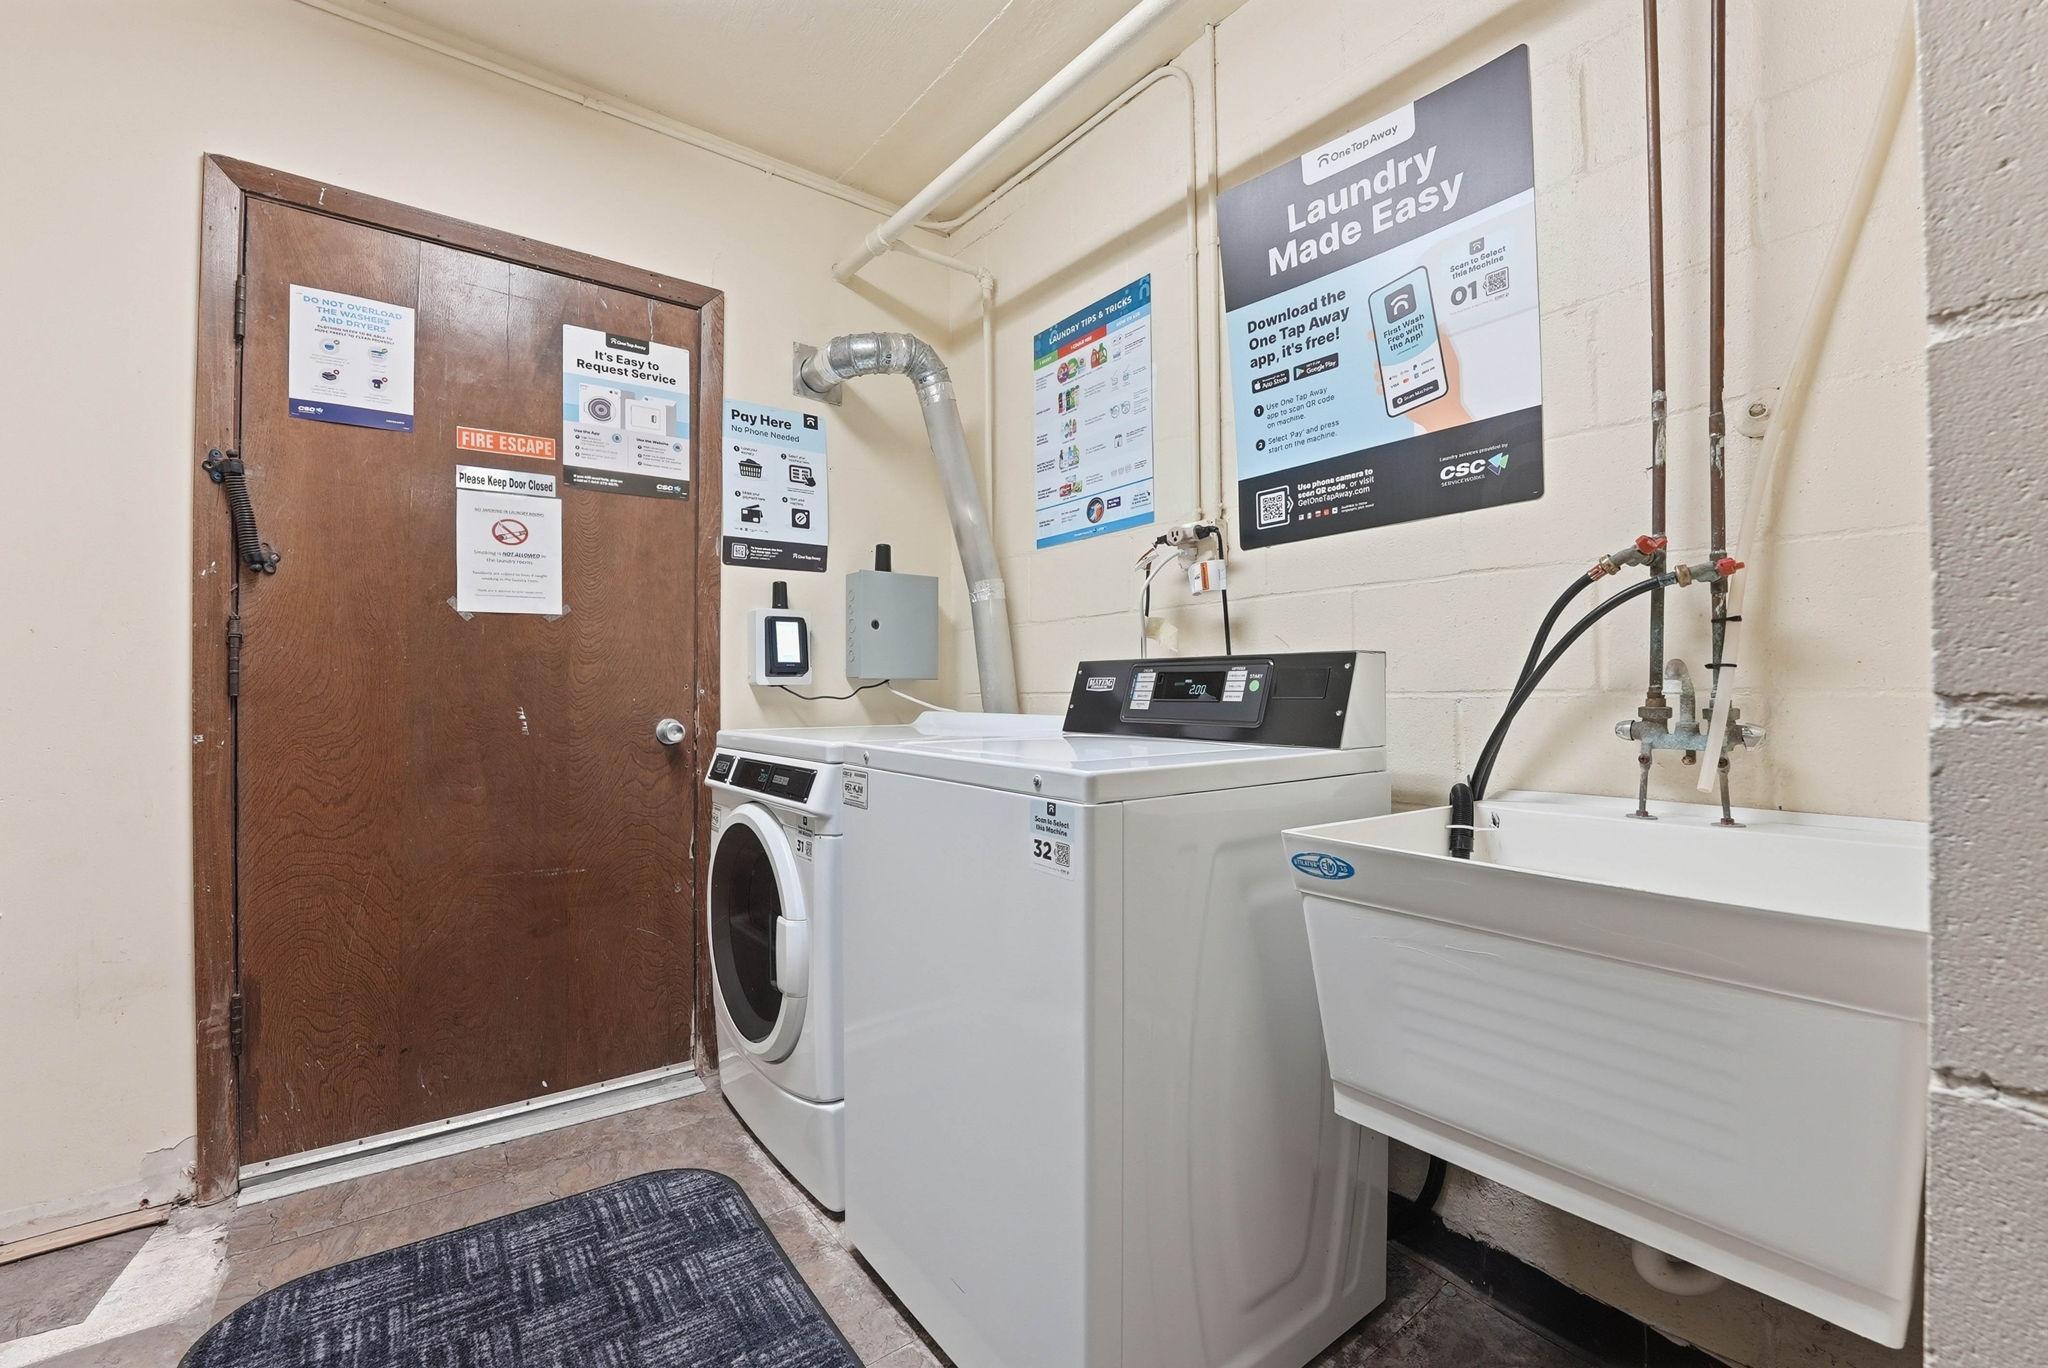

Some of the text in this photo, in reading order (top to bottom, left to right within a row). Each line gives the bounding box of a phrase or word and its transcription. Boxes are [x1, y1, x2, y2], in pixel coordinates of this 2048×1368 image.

[1330, 124, 1398, 162] One Tap Away
[1287, 145, 1437, 233] Laundry
[1268, 172, 1464, 277] Made Easy
[1450, 261, 1469, 273] Scan
[1480, 245, 1506, 260] Select
[1452, 255, 1505, 280] this Machine
[1451, 281, 1477, 306] 01
[303, 295, 402, 320] DO NOT OVERLOAD
[316, 306, 390, 326] THE WASHERS
[1247, 290, 1346, 334] Download the
[320, 316, 387, 333] AND DRYERS
[1048, 295, 1132, 345] LAUNDRY TIPS & TRICKS
[1249, 307, 1349, 351] One Tap Away
[1383, 313, 1425, 339] First Wash
[1387, 322, 1424, 345] Free with
[1389, 340, 1404, 352] the
[1404, 330, 1424, 346] App!
[1250, 327, 1340, 369] app, it's free!
[577, 358, 676, 385] Request Service
[595, 350, 659, 371] It's Easy to
[1306, 360, 1337, 374] Google Play
[1273, 376, 1288, 385] Store
[1266, 387, 1328, 411] Use One Tap Away
[1267, 394, 1335, 420] app to scan QR code
[731, 409, 792, 430] Pay Here
[462, 431, 552, 456] FIRE ESCAPE
[731, 424, 800, 443] No Phone Needed
[1268, 434, 1288, 445] Select
[1305, 425, 1319, 434] and
[1320, 420, 1340, 431] press
[1268, 444, 1283, 454] start
[1284, 442, 1293, 450] on
[1294, 438, 1305, 447] the
[1297, 483, 1311, 491] Use
[1311, 478, 1335, 489] phone
[1335, 471, 1364, 482] camera
[1440, 459, 1486, 480] CSC
[459, 472, 553, 492] Please Keep Door Closed
[1297, 491, 1315, 499] scan
[1315, 487, 1327, 495] QR
[1359, 476, 1375, 486] visit
[1297, 486, 1370, 507] GetOneTapAway.com
[1189, 684, 1207, 695] 2.00
[1035, 815, 1047, 823] Scan
[1053, 819, 1070, 829] Select
[1046, 826, 1067, 837] Machine
[796, 839, 804, 853] 31
[1033, 838, 1052, 861] 32
